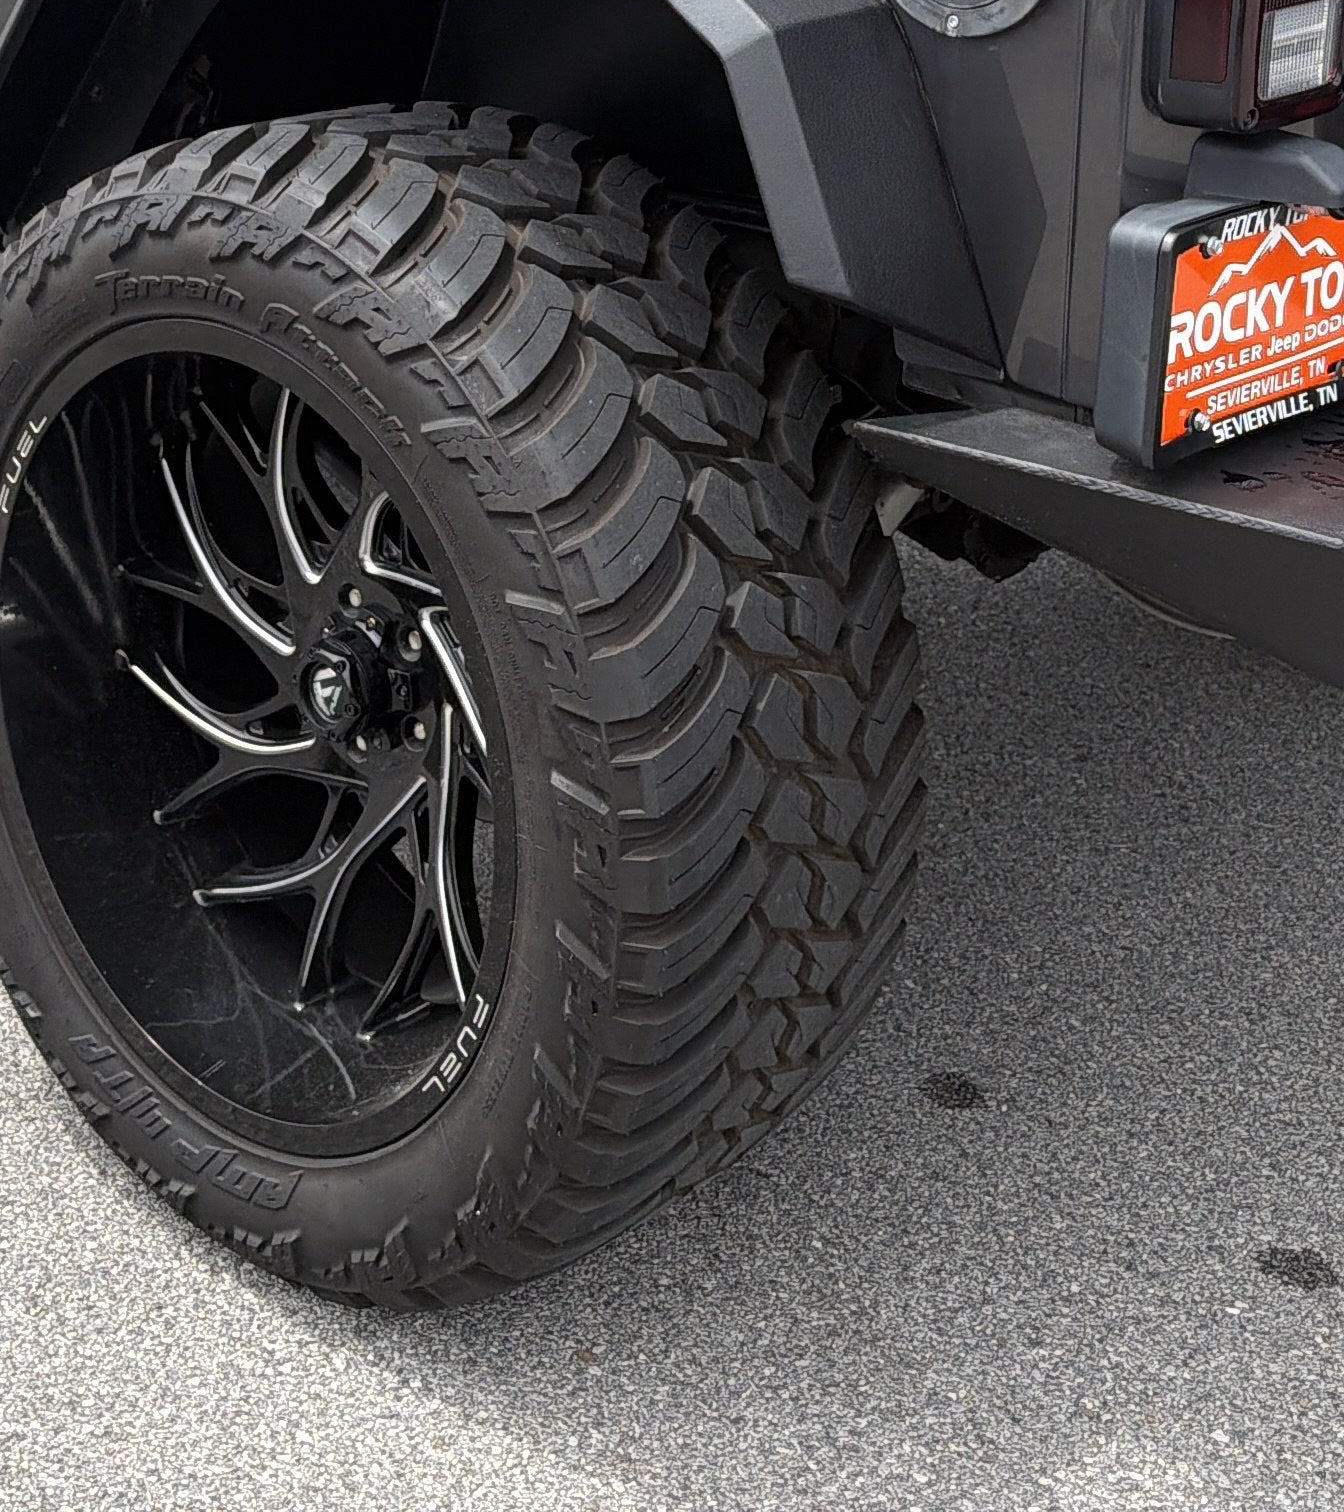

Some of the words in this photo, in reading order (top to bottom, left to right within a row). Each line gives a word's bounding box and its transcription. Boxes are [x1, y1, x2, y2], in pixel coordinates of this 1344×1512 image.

[1220, 204, 1283, 244] ROCKY
[94, 268, 245, 316] Terrain
[1168, 275, 1296, 364] ROCKY
[1164, 344, 1262, 392] CHRYSLER
[1267, 332, 1301, 360] Jeep
[1207, 365, 1304, 415] SEVIERVILLE,
[1308, 356, 1326, 379] TN
[1212, 395, 1314, 445] SEVIERVILLE,
[1319, 383, 1338, 407] TN
[421, 993, 490, 1093] FUEL
